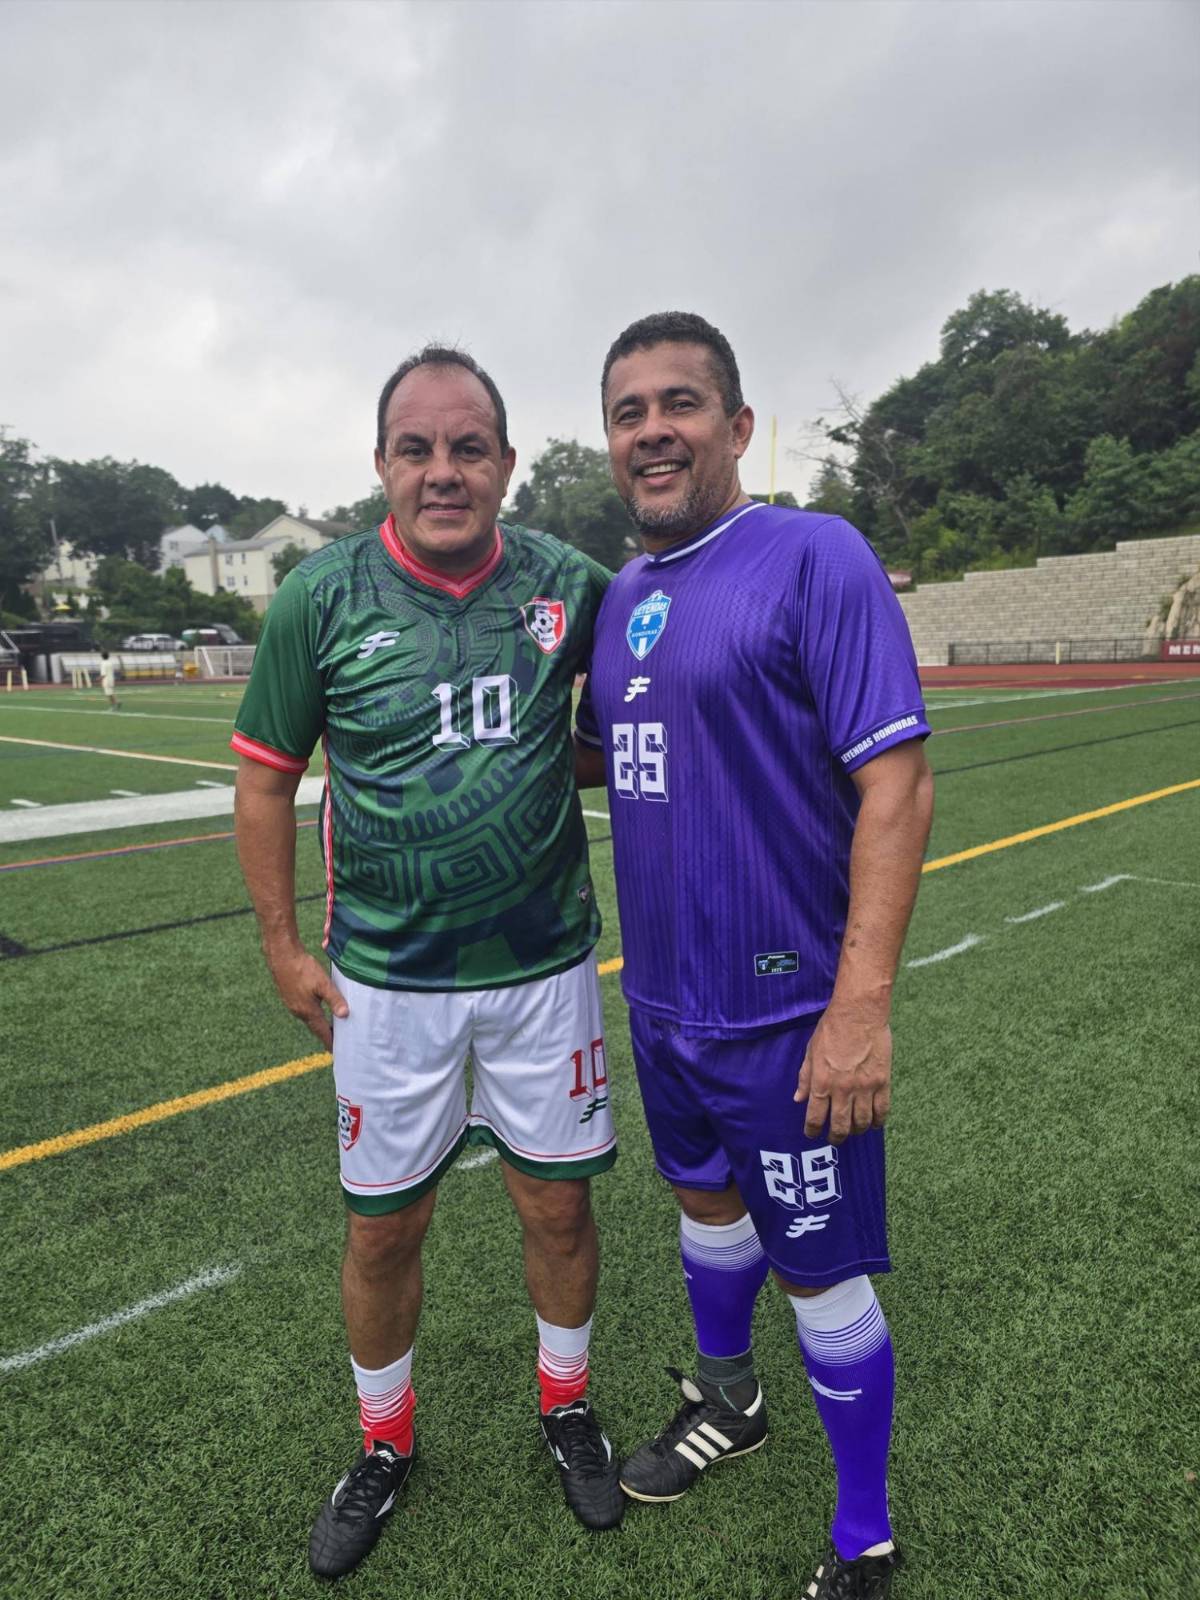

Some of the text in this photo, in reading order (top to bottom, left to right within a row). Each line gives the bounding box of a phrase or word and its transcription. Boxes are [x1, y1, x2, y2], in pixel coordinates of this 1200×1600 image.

[431, 674, 519, 751] 10
[872, 715, 919, 743] HONDURAS
[612, 722, 669, 803] 25
[569, 1038, 608, 1102] 10
[760, 1144, 842, 1210] 25
